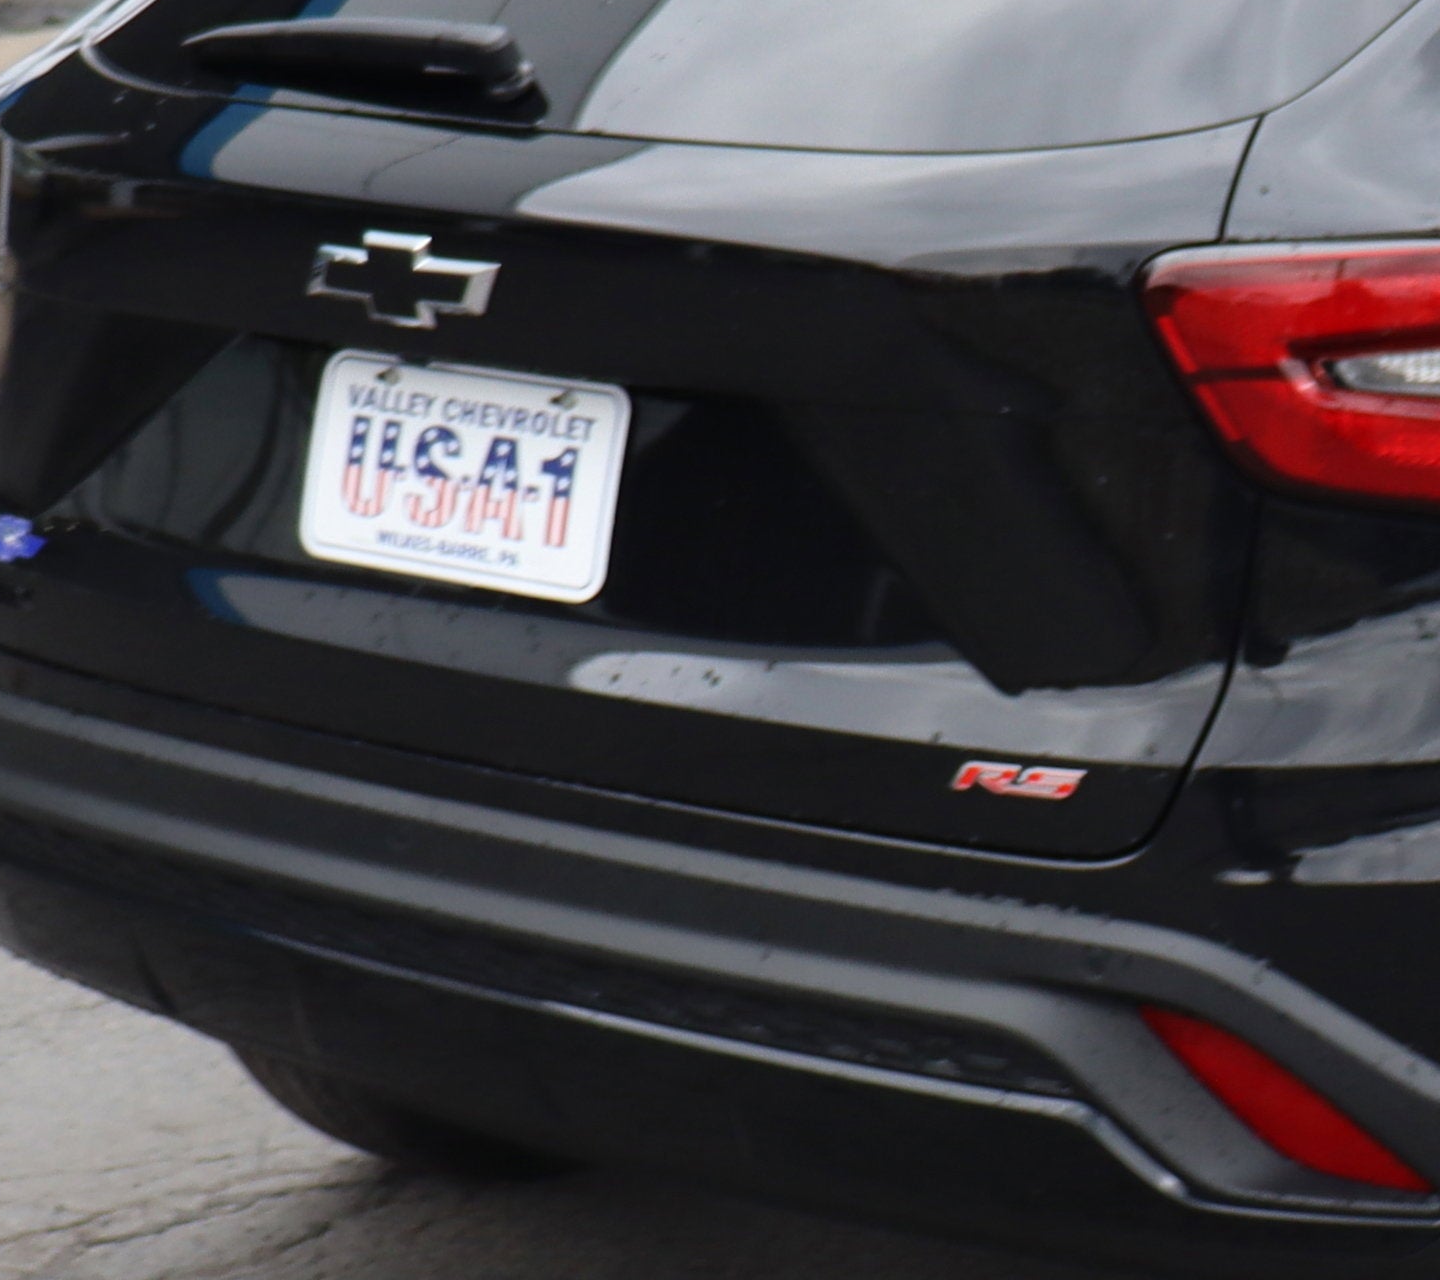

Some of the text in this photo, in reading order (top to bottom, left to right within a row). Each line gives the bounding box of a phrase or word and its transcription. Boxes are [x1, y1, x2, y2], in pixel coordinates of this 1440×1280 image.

[347, 383, 598, 442] VALLEY CHEVROLET
[951, 760, 1088, 800] RS
